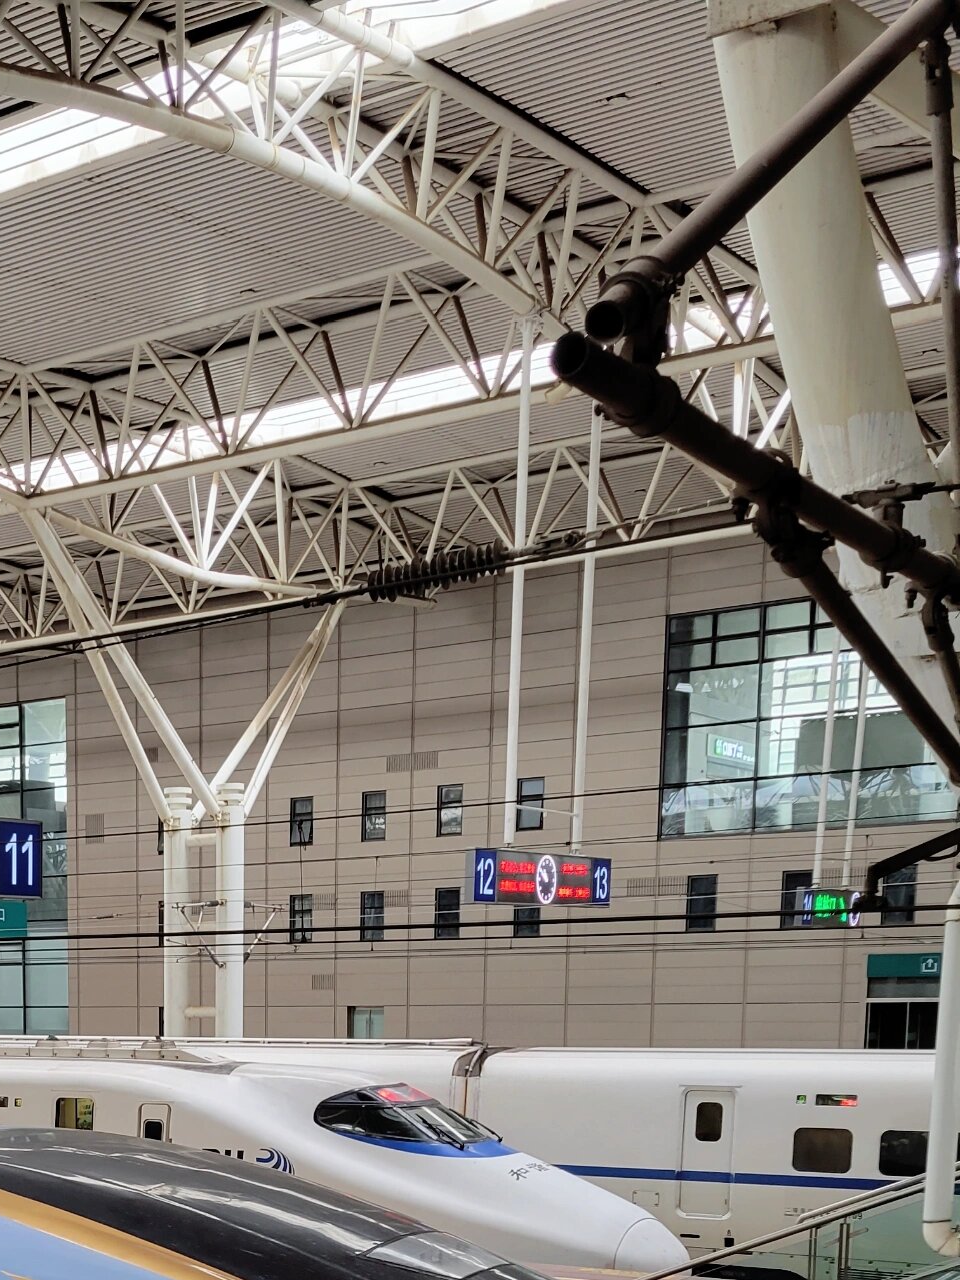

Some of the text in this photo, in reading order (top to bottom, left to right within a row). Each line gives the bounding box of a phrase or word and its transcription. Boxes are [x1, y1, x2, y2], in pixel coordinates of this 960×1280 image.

[5, 832, 33, 886] 11
[477, 857, 494, 895] 12
[594, 866, 608, 899] 13
